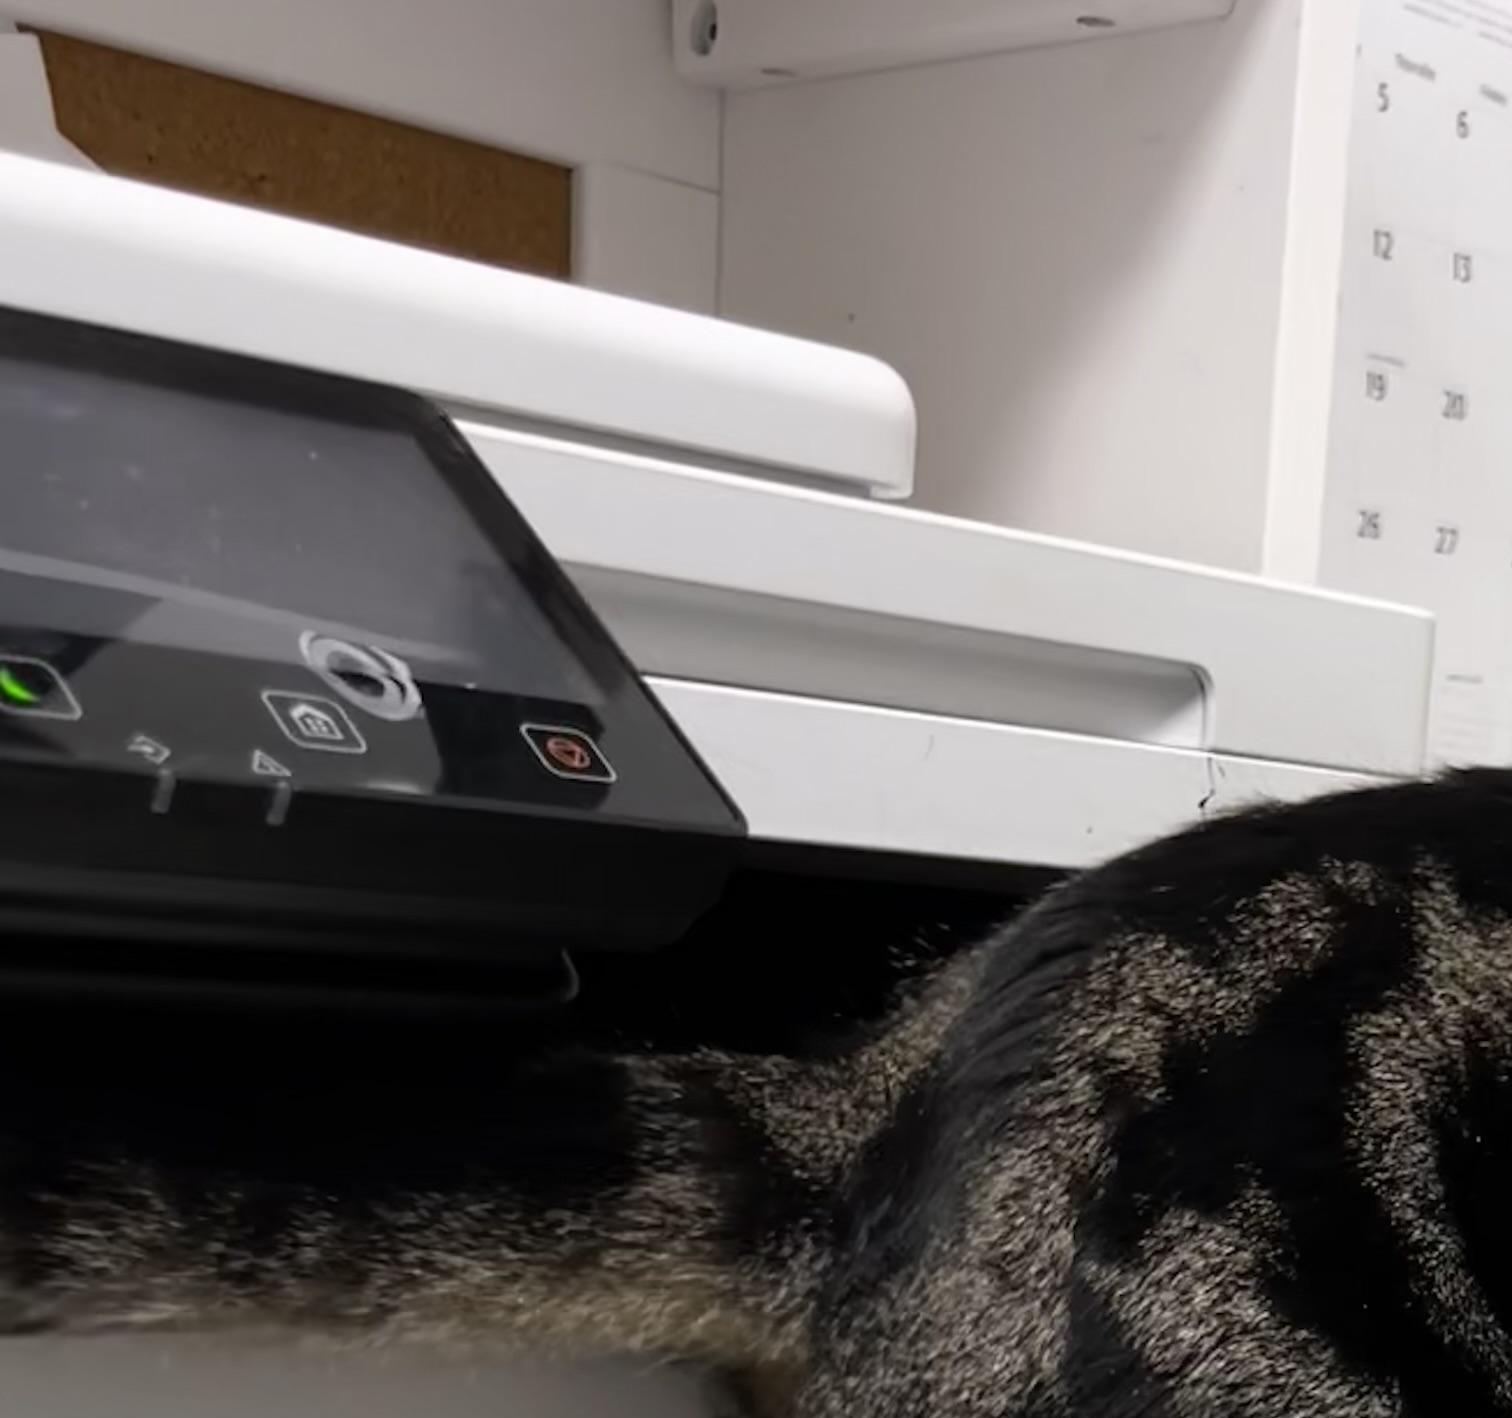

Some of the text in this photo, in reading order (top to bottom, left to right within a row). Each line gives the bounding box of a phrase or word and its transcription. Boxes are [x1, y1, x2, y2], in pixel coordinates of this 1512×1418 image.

[1377, 82, 1390, 112] 5
[1456, 110, 1470, 139] 6
[1373, 229, 1394, 261] 12
[1453, 252, 1472, 283] 13
[1366, 372, 1386, 401] 19
[1442, 390, 1466, 420] 20
[1357, 510, 1380, 539] 26
[1434, 526, 1458, 554] 27
